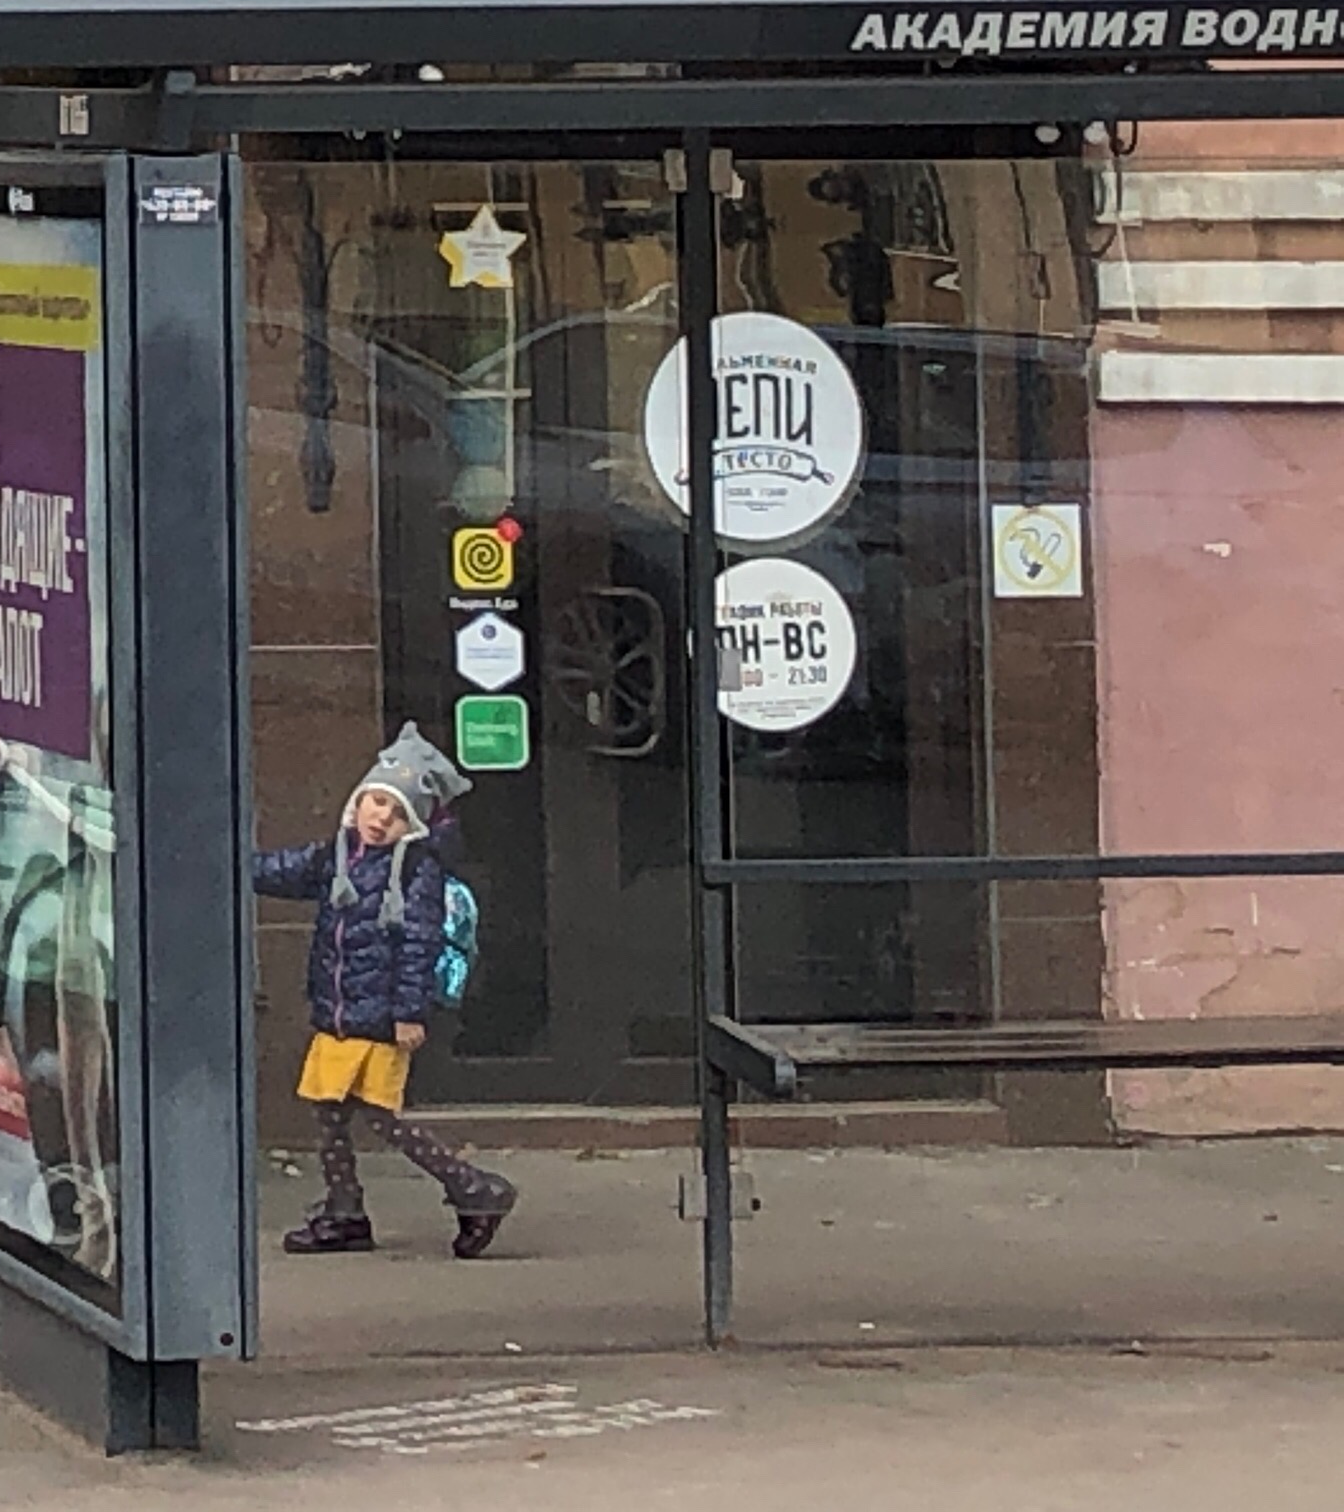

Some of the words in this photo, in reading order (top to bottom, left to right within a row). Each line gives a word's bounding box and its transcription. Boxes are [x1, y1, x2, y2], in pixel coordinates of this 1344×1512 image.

[851, 10, 1169, 55] АКАДЕМИЯ
[1181, 7, 1344, 53] ВОДН
[713, 373, 813, 446] ЕПИ
[722, 451, 793, 471] ТЕСТО
